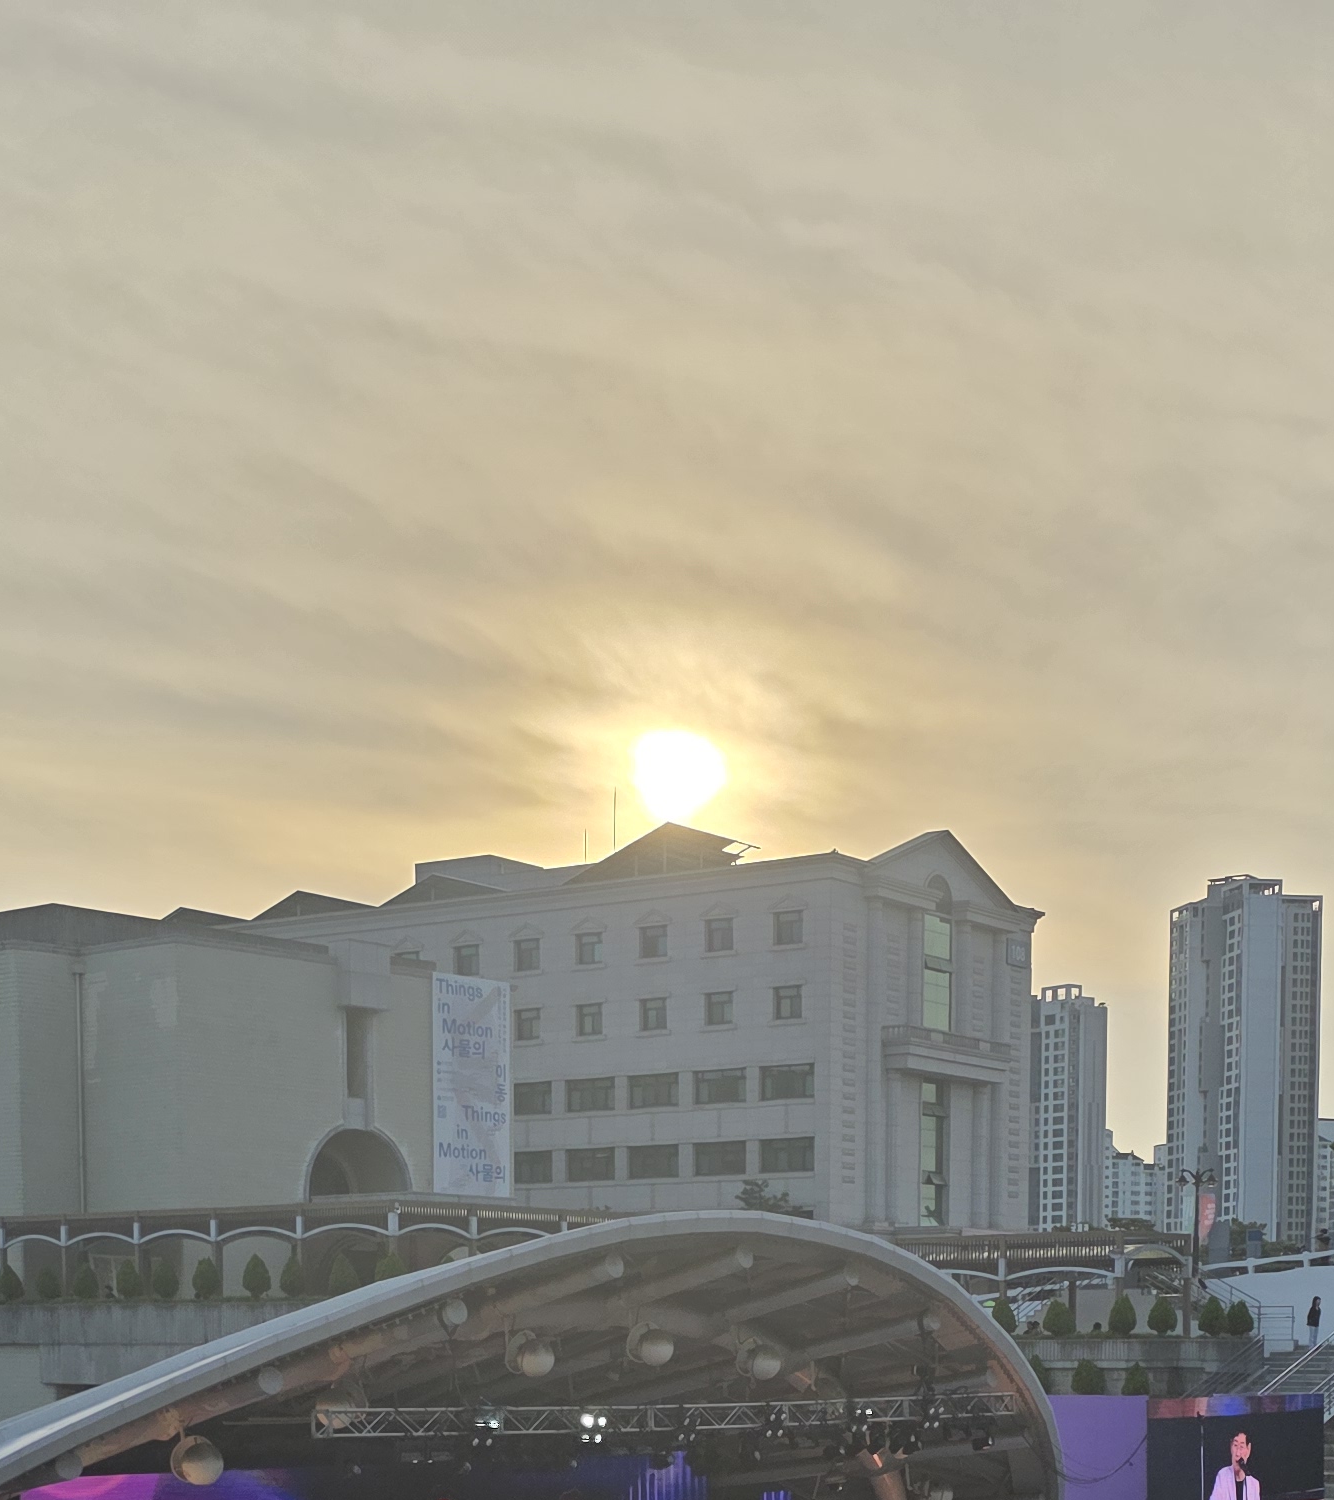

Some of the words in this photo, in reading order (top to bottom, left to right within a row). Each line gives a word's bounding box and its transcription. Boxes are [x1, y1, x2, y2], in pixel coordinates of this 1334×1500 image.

[1011, 945, 1025, 961] 108
[436, 978, 483, 1001] Things
[438, 998, 450, 1014] in
[442, 1018, 493, 1038] Motion
[442, 1037, 485, 1060] 사물의
[462, 1105, 506, 1127] Things
[456, 1124, 468, 1140] in
[438, 1142, 487, 1160] Motion
[469, 1163, 505, 1183] 사물의
